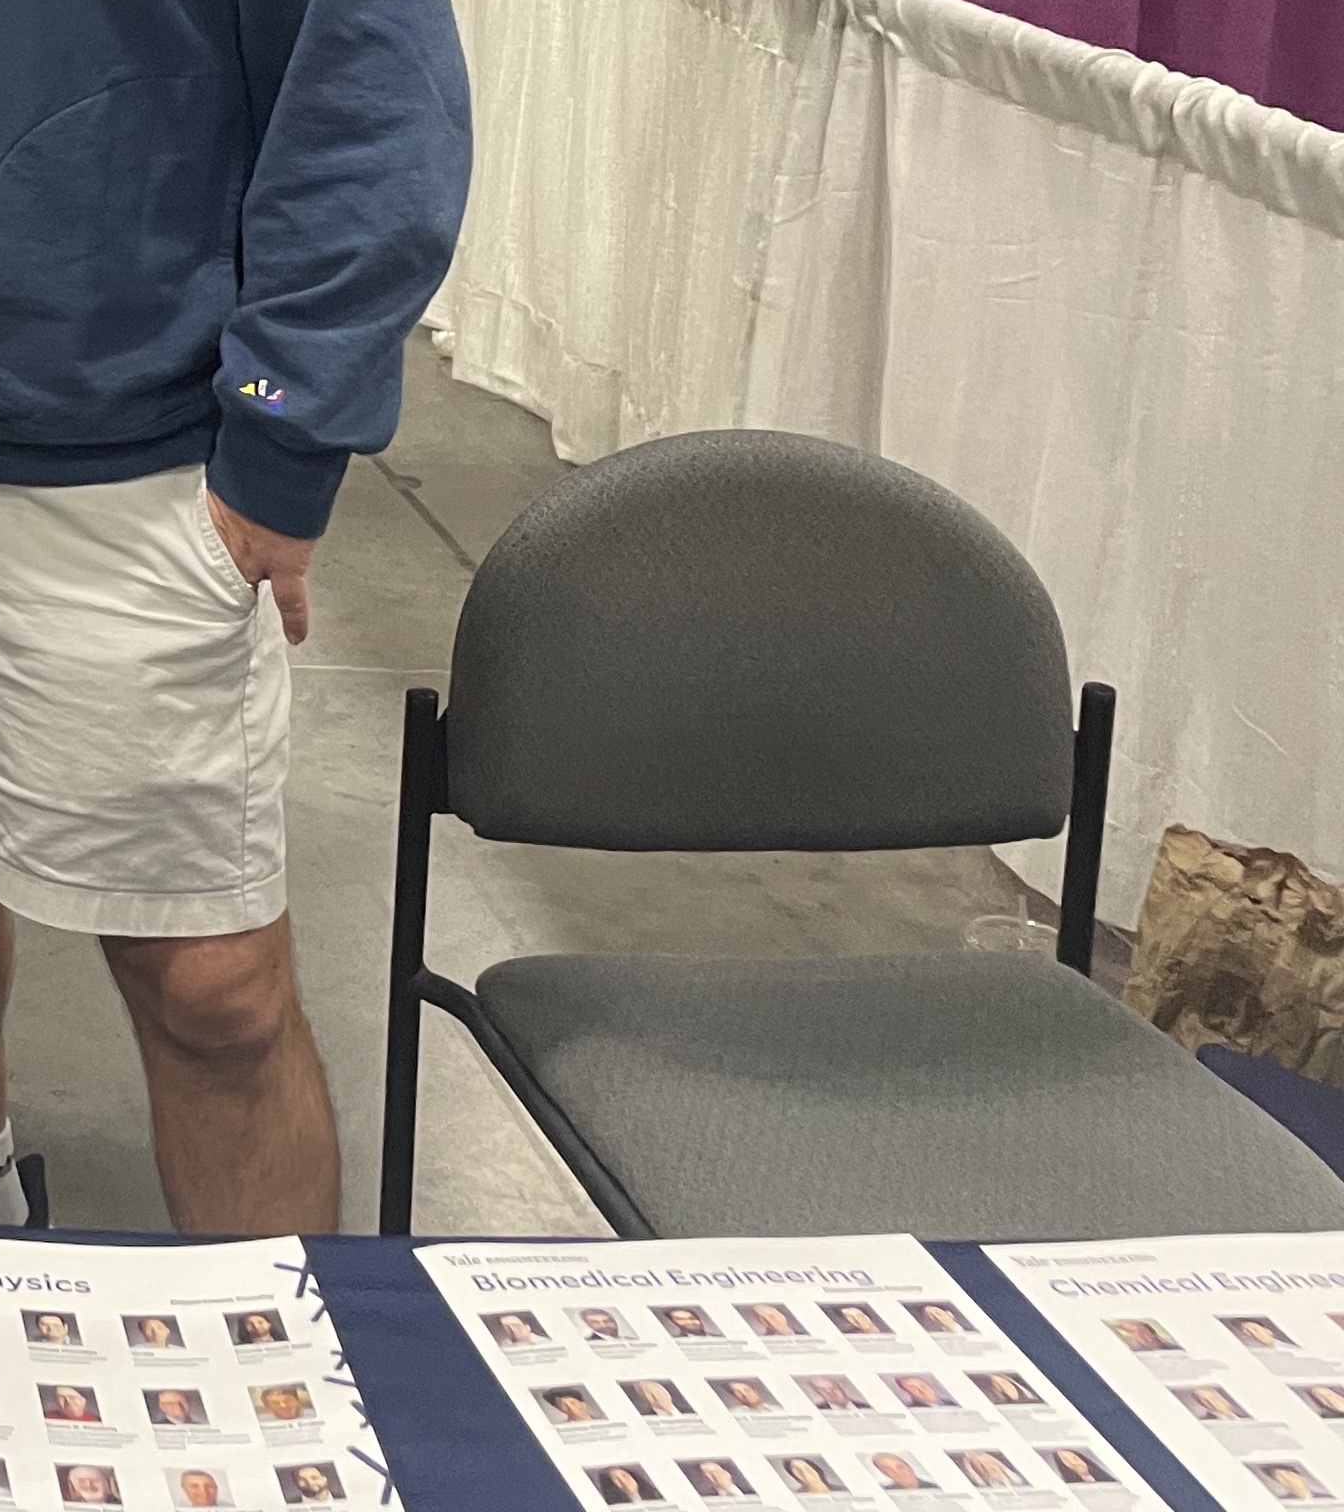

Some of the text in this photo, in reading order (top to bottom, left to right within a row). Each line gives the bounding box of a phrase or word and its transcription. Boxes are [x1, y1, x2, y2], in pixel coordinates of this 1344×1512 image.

[443, 1253, 483, 1267] Yale
[470, 1264, 875, 1292] Biomedical Engineering
[1048, 1271, 1213, 1298] Chemical
